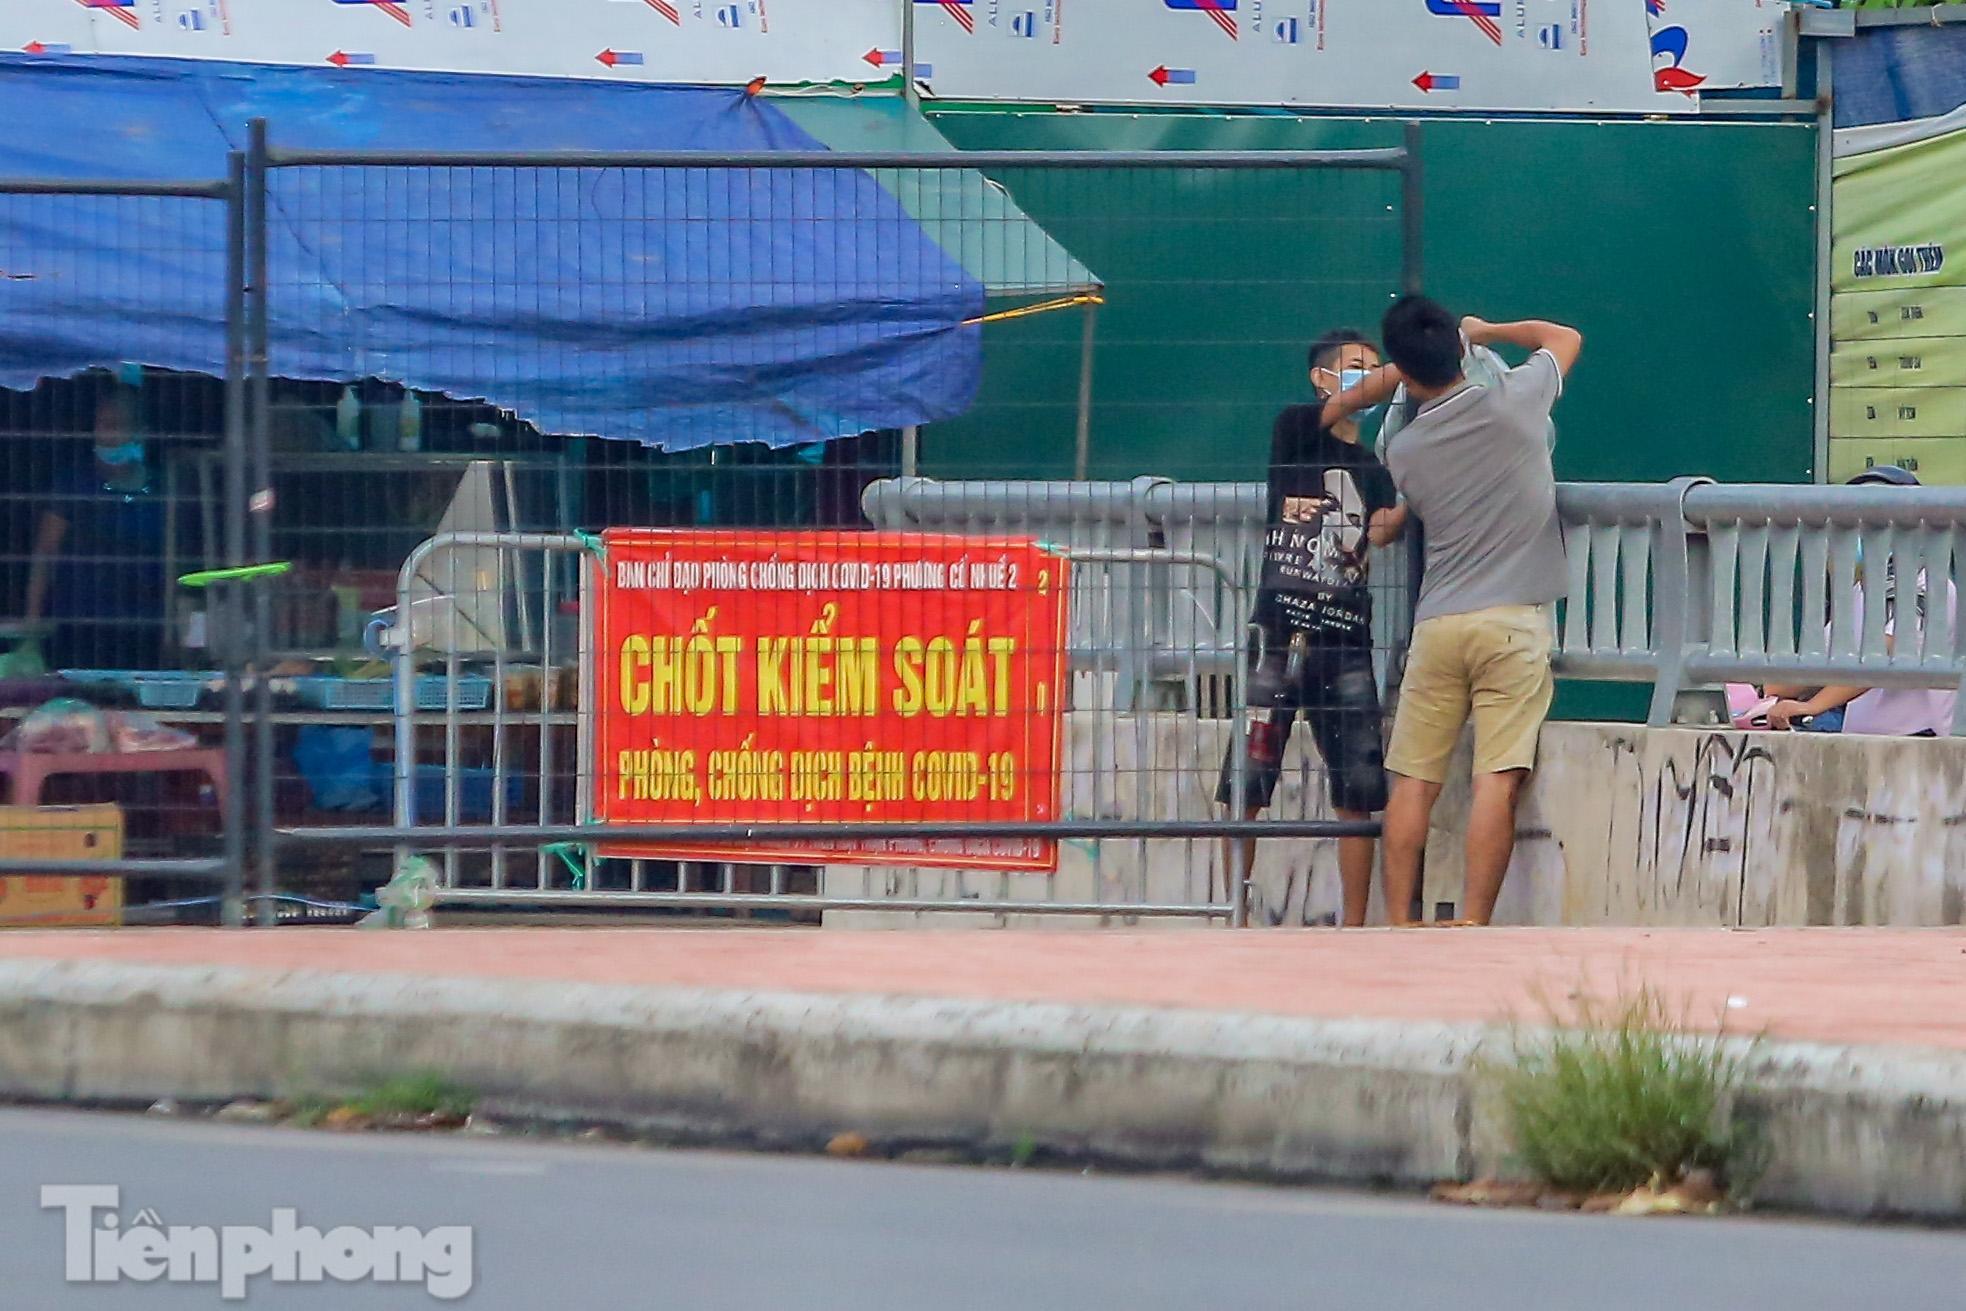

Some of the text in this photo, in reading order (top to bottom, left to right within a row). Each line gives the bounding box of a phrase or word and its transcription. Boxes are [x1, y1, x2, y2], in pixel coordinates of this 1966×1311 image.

[617, 561, 644, 588] BAN
[648, 551, 672, 588] CHỈ
[674, 562, 699, 595] ĐẠO
[703, 556, 747, 588] PHÒNG
[751, 553, 794, 588] CHỐNG
[798, 562, 828, 595] DỊCH
[832, 562, 890, 589] COVID-19
[1008, 563, 1017, 588] 2
[619, 602, 1015, 718] CHỐT KIỂM SOÁT
[618, 732, 1014, 812] PHÒNG, CHỐNG DỊCH BỆNH COVID-19
